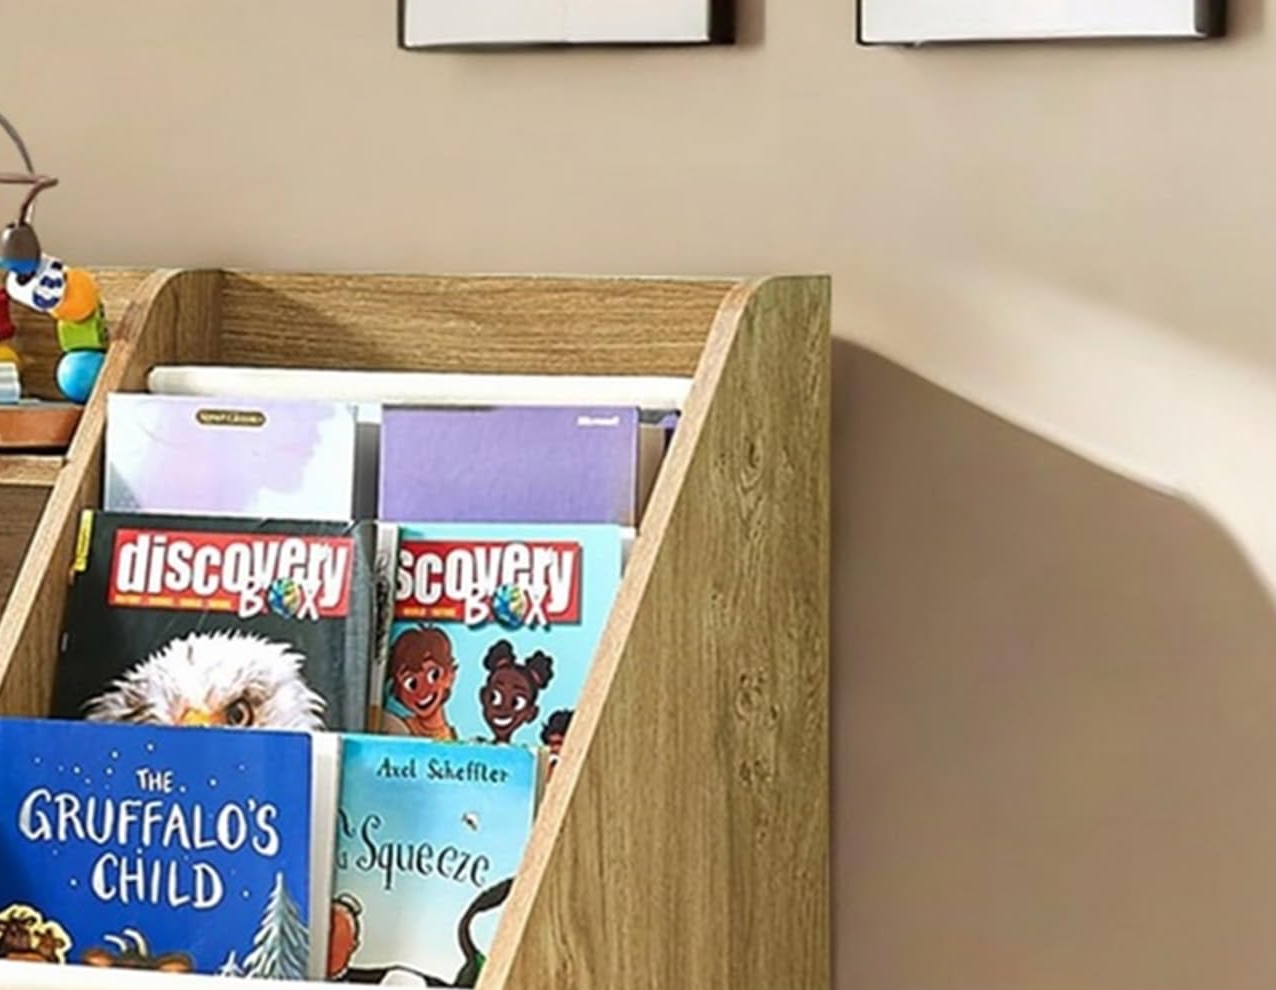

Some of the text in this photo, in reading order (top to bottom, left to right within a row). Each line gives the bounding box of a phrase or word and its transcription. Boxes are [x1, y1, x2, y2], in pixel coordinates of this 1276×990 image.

[115, 533, 348, 609] discovery
[396, 541, 574, 614] scovery
[135, 768, 174, 794] THE
[376, 757, 510, 783] Axel Scheffler
[18, 787, 280, 857] GRUFFALO'S
[356, 814, 490, 890] Squeeze
[90, 852, 224, 909] CHILD
